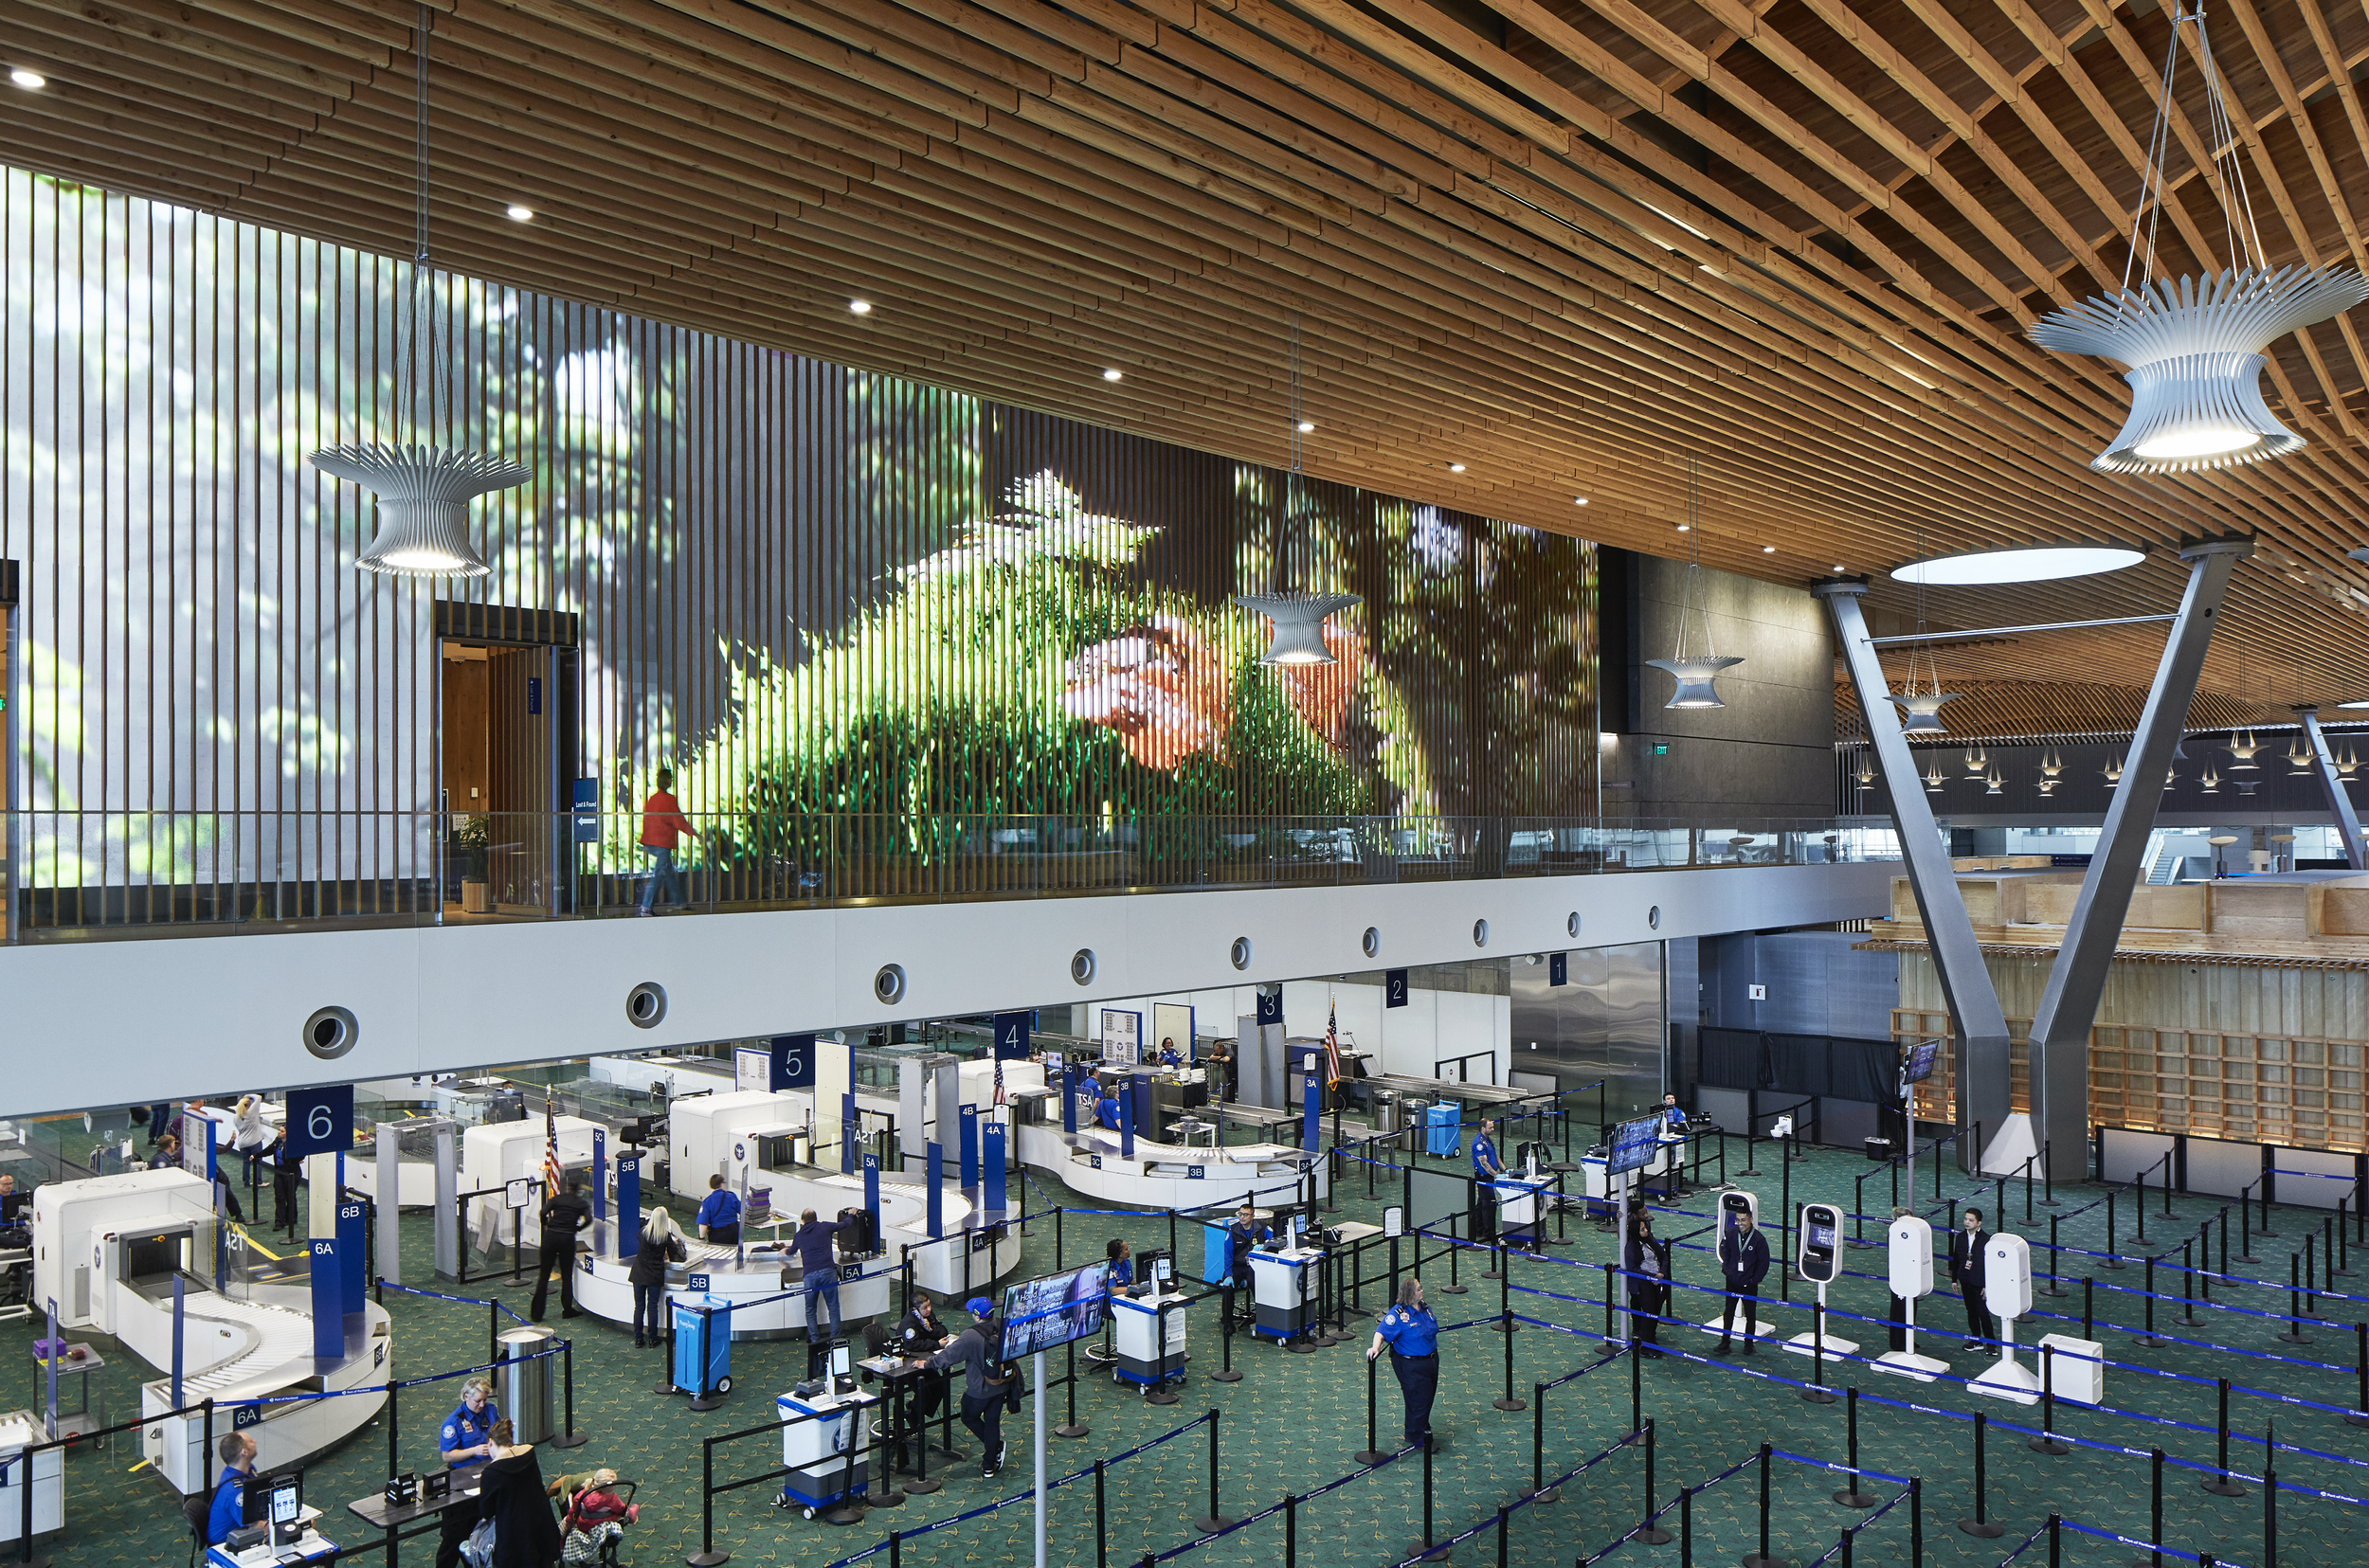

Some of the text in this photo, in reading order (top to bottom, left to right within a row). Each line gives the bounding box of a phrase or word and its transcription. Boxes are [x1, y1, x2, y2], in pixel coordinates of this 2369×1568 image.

[1557, 962, 1561, 978] 1
[1393, 980, 1401, 999] 2
[1265, 995, 1275, 1016] 3
[1006, 1024, 1019, 1048] 4
[786, 1049, 802, 1076] 5
[1121, 1082, 1129, 1090] 3B
[1308, 1079, 1316, 1088] 3A
[1077, 1093, 1093, 1107] TSA
[308, 1105, 332, 1139] 6
[987, 1126, 1000, 1135] 4A
[595, 1132, 603, 1142] 5C
[622, 1162, 635, 1171] 5B
[866, 1158, 876, 1168] 5A
[1191, 1168, 1202, 1177] 3B
[341, 1206, 359, 1217] 6B
[974, 1237, 984, 1247] 4A
[316, 1243, 333, 1254] 6A
[586, 1261, 592, 1271] 5C
[845, 1267, 859, 1278] 5A
[692, 1278, 707, 1289] 5B
[238, 1410, 256, 1423] 6A
